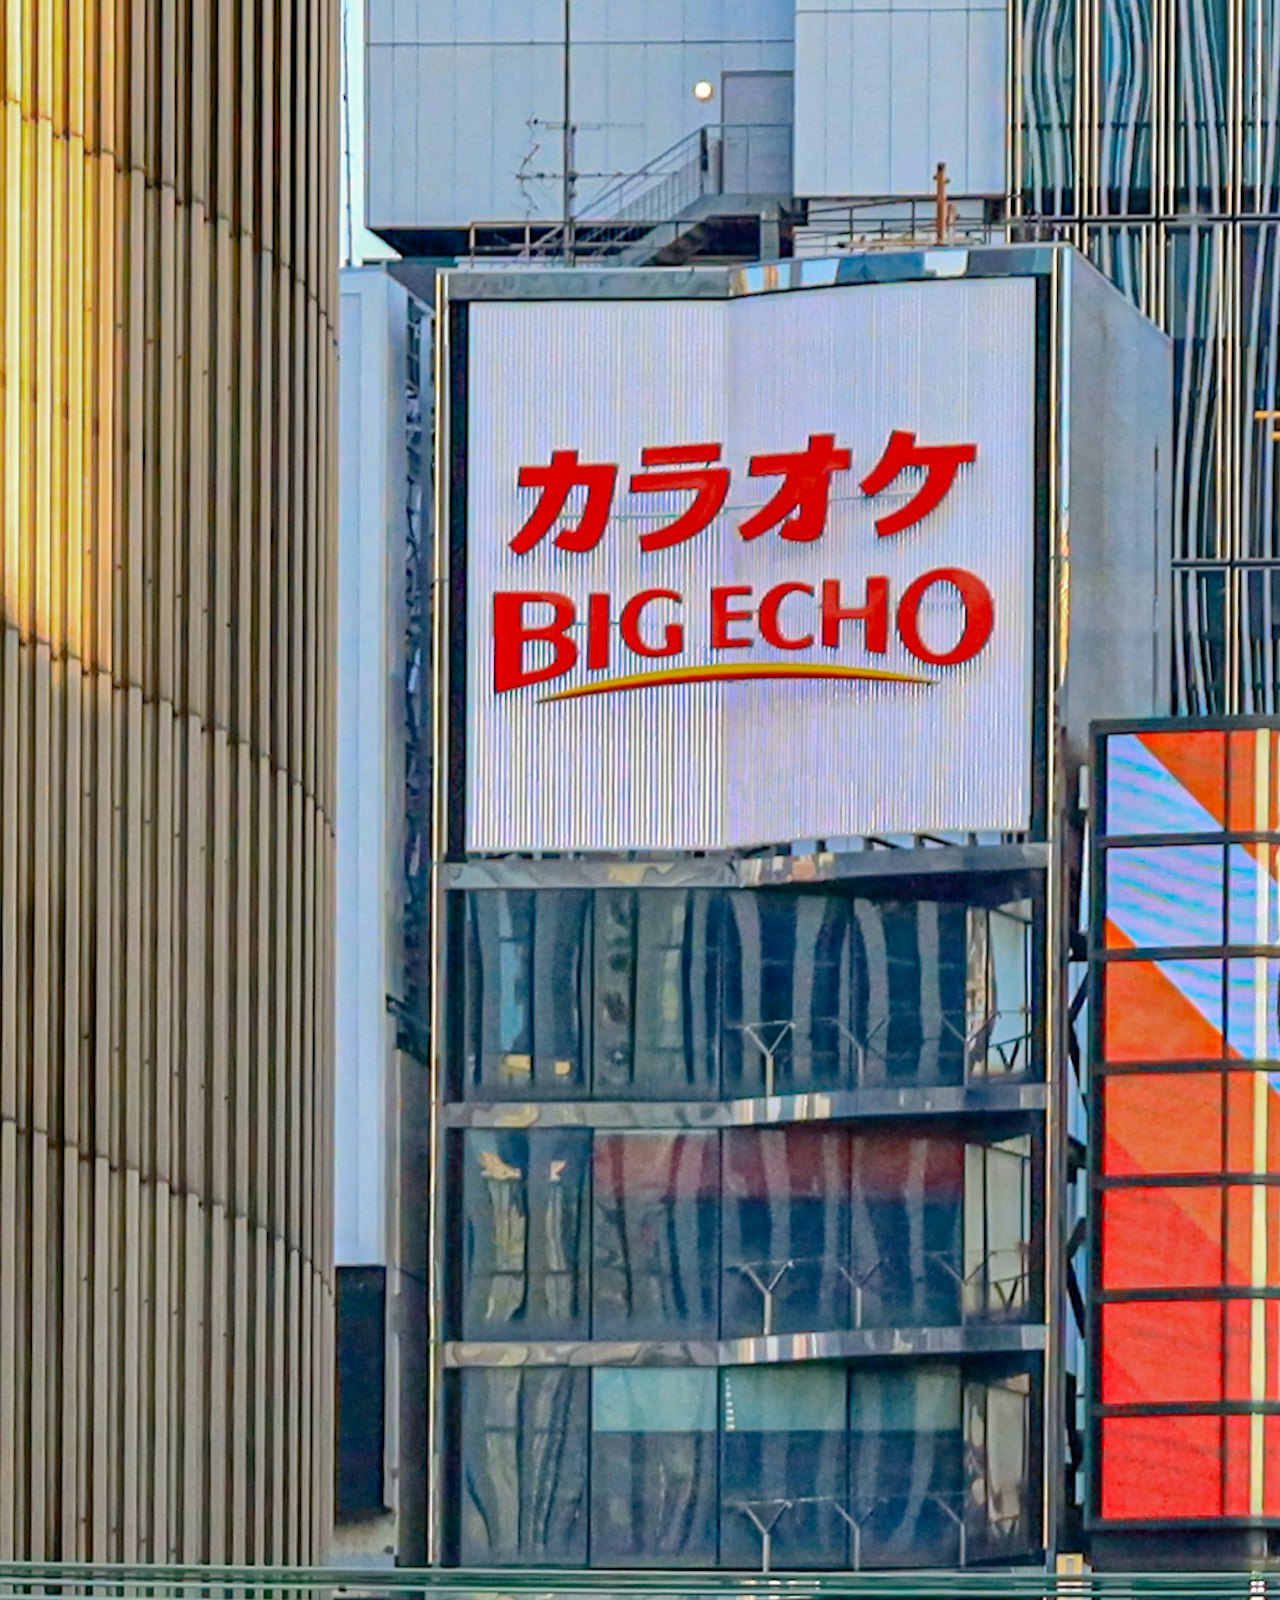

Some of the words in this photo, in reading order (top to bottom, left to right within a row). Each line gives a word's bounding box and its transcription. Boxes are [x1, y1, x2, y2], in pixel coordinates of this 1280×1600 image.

[508, 429, 979, 555] カラオケ
[493, 587, 684, 694] BIG
[711, 566, 995, 666] ECHO
